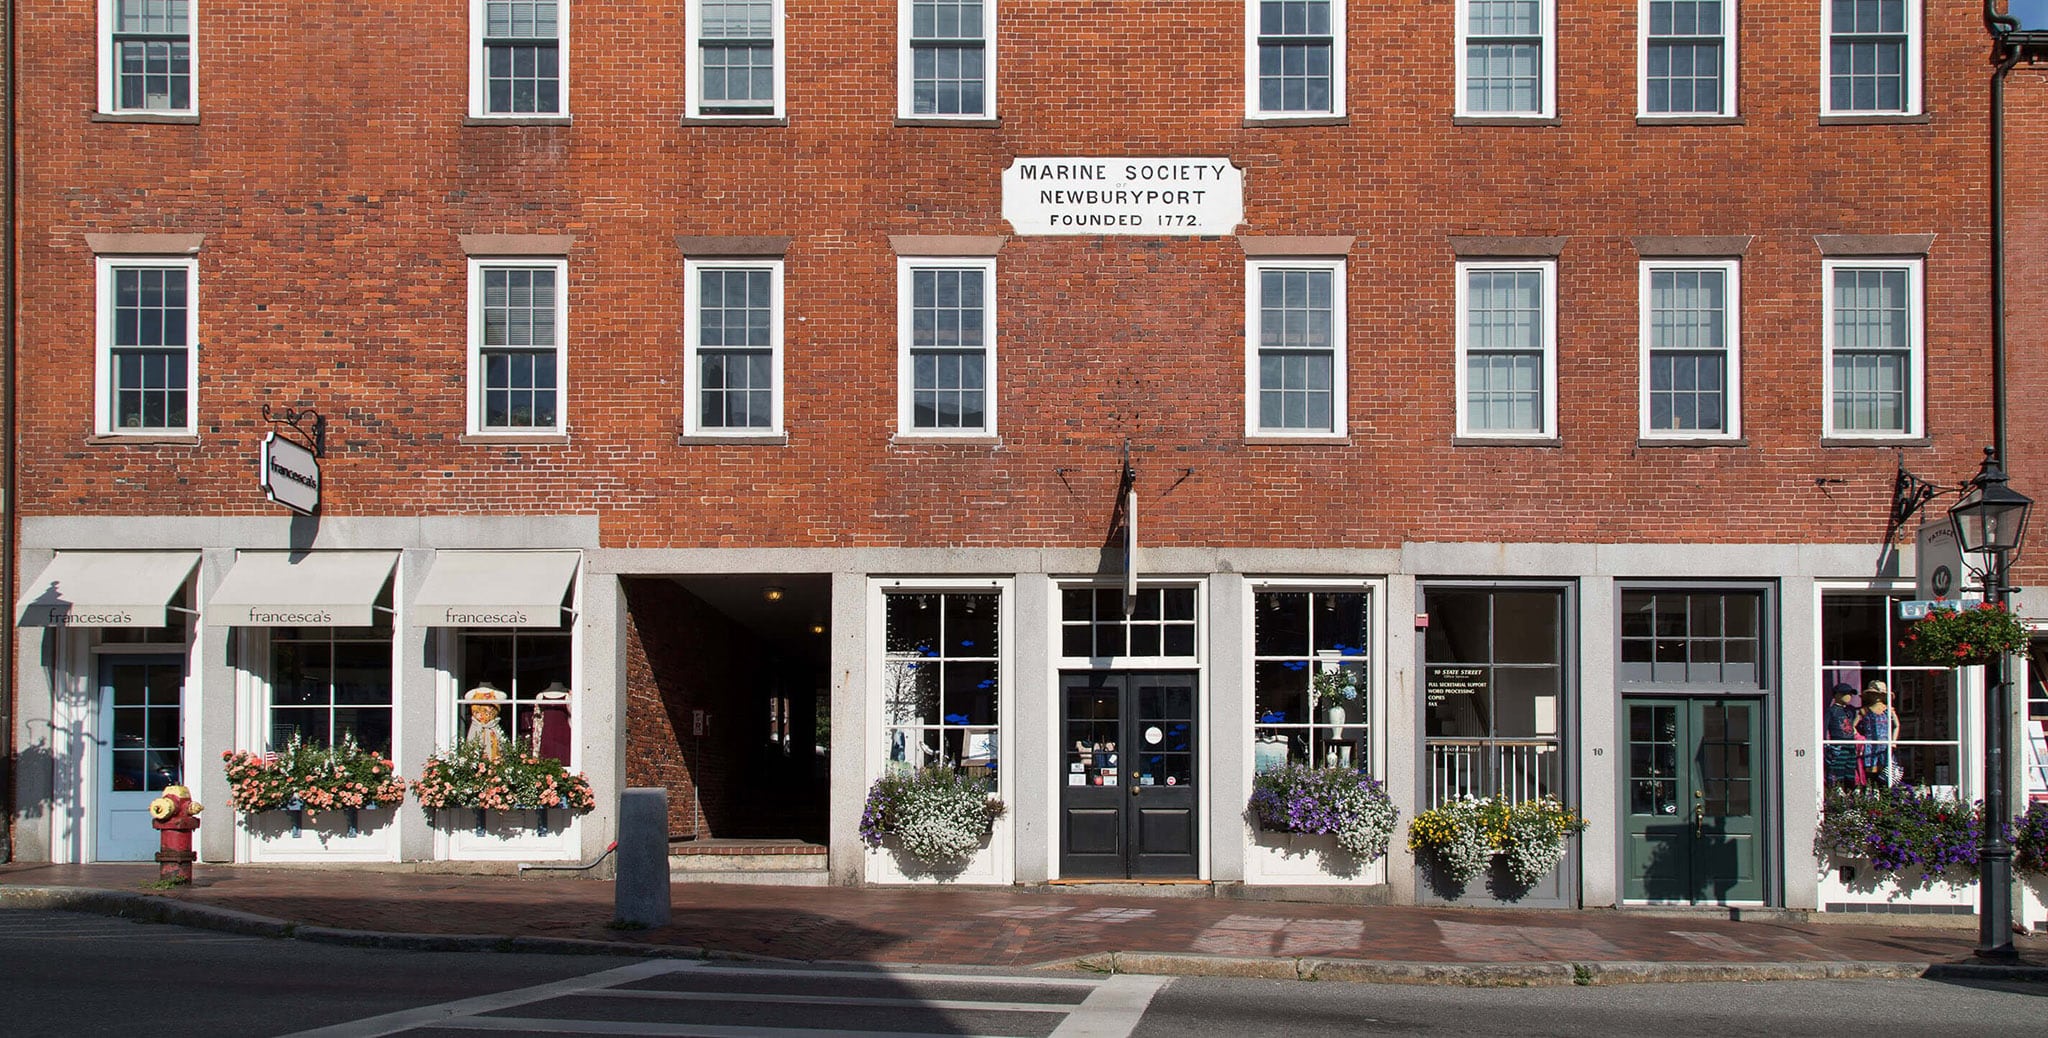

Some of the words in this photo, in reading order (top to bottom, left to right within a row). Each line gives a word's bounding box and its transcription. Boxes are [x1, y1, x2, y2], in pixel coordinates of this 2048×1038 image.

[1020, 165, 1106, 180] MARINE
[1125, 165, 1225, 180] SOCIETY
[1040, 190, 1206, 204] NEWBURYPORT
[1050, 215, 1143, 226] FOUNDED
[1158, 215, 1202, 226] 1772.
[270, 455, 317, 489] francesca's
[49, 607, 132, 623] francesca's
[249, 606, 332, 622] francesca's
[446, 607, 527, 623] francesca's
[1592, 748, 1604, 756] 10
[1794, 749, 1805, 757] 10
